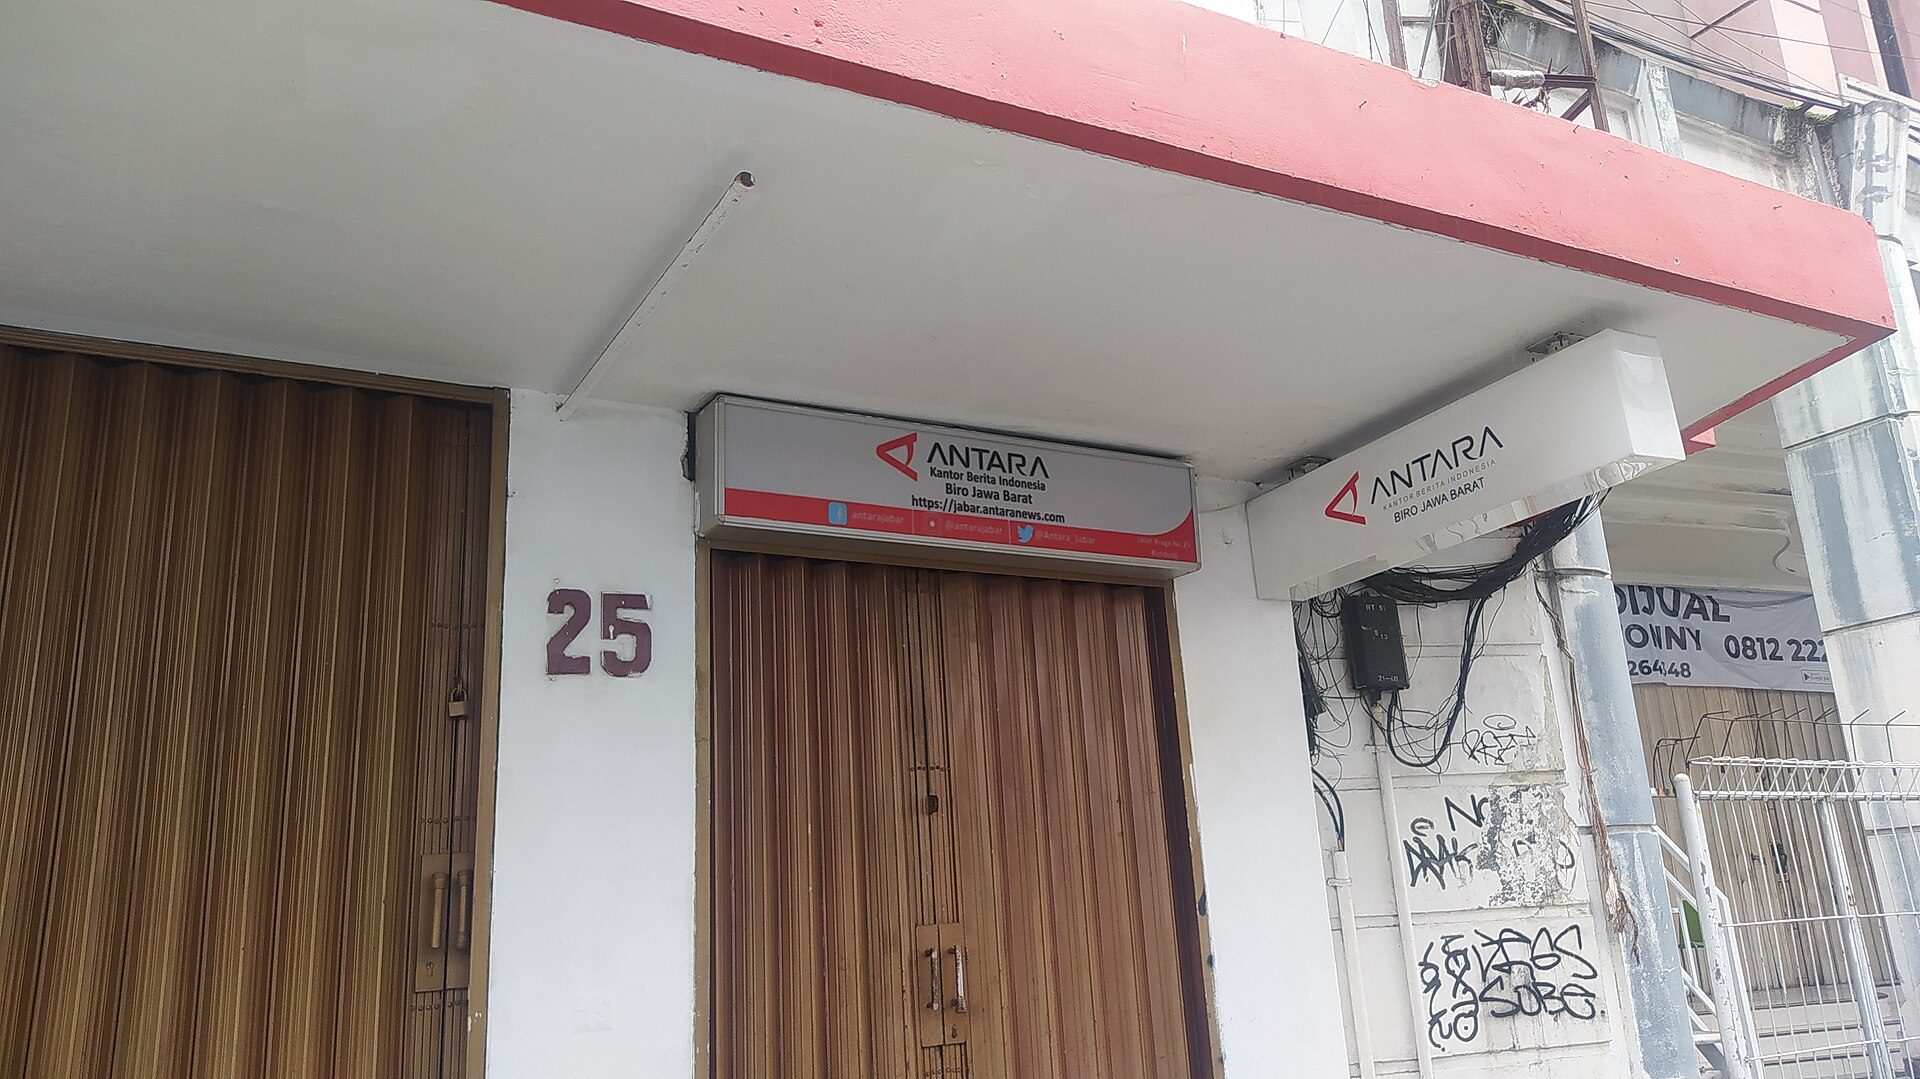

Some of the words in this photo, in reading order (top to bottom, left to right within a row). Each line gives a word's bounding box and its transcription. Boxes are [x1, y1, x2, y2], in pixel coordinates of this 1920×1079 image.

[927, 442, 1050, 479] ANTARA
[930, 466, 964, 481] Kantor
[967, 472, 996, 485] Berita
[999, 475, 1046, 491] Indonesia
[1371, 426, 1504, 505] ANTARA
[945, 483, 969, 497] Biro
[972, 487, 1000, 501] Jawa
[1003, 490, 1033, 505] Barat
[1383, 493, 1414, 511] KANTOR
[1416, 480, 1446, 497] BERITA
[1447, 459, 1496, 485] INDONESIA
[1394, 505, 1418, 523] BIRO
[1420, 493, 1449, 512] JAWA
[1450, 477, 1485, 500] BARAT
[911, 494, 1065, 523] https://jabar.antaranews.com
[547, 588, 652, 677] 25
[1621, 624, 1702, 650] ONNY
[1724, 635, 1784, 660] 0812
